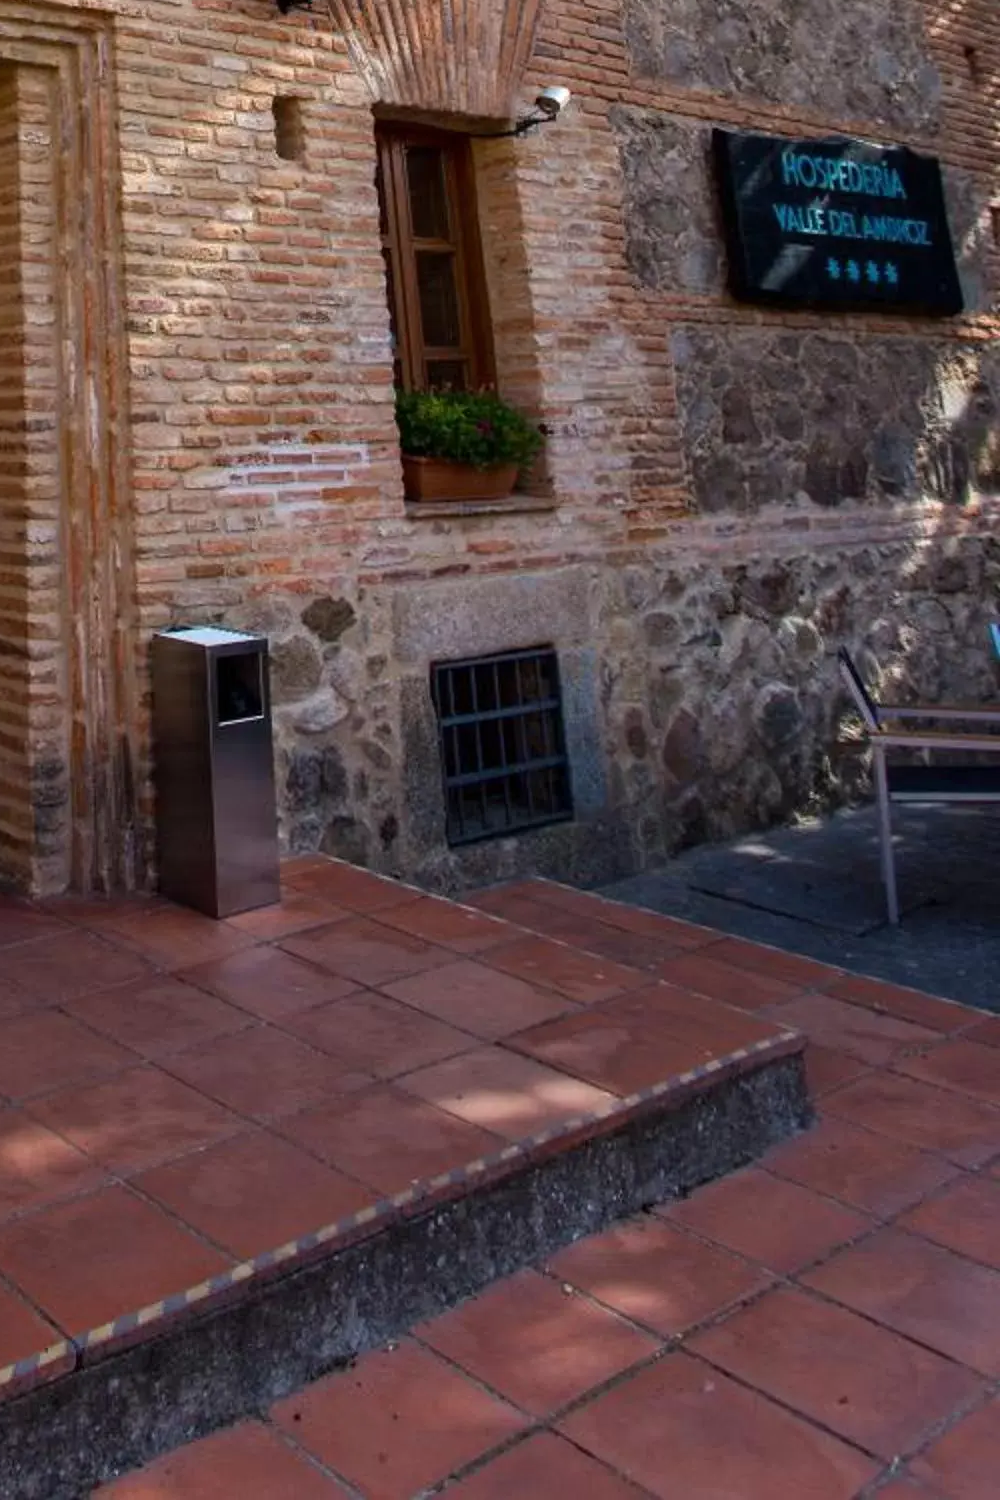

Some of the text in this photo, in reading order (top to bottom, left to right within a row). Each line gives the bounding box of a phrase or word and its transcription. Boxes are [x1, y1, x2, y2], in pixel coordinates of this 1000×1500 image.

[772, 202, 933, 246] VALLE DEL AMBROZ
